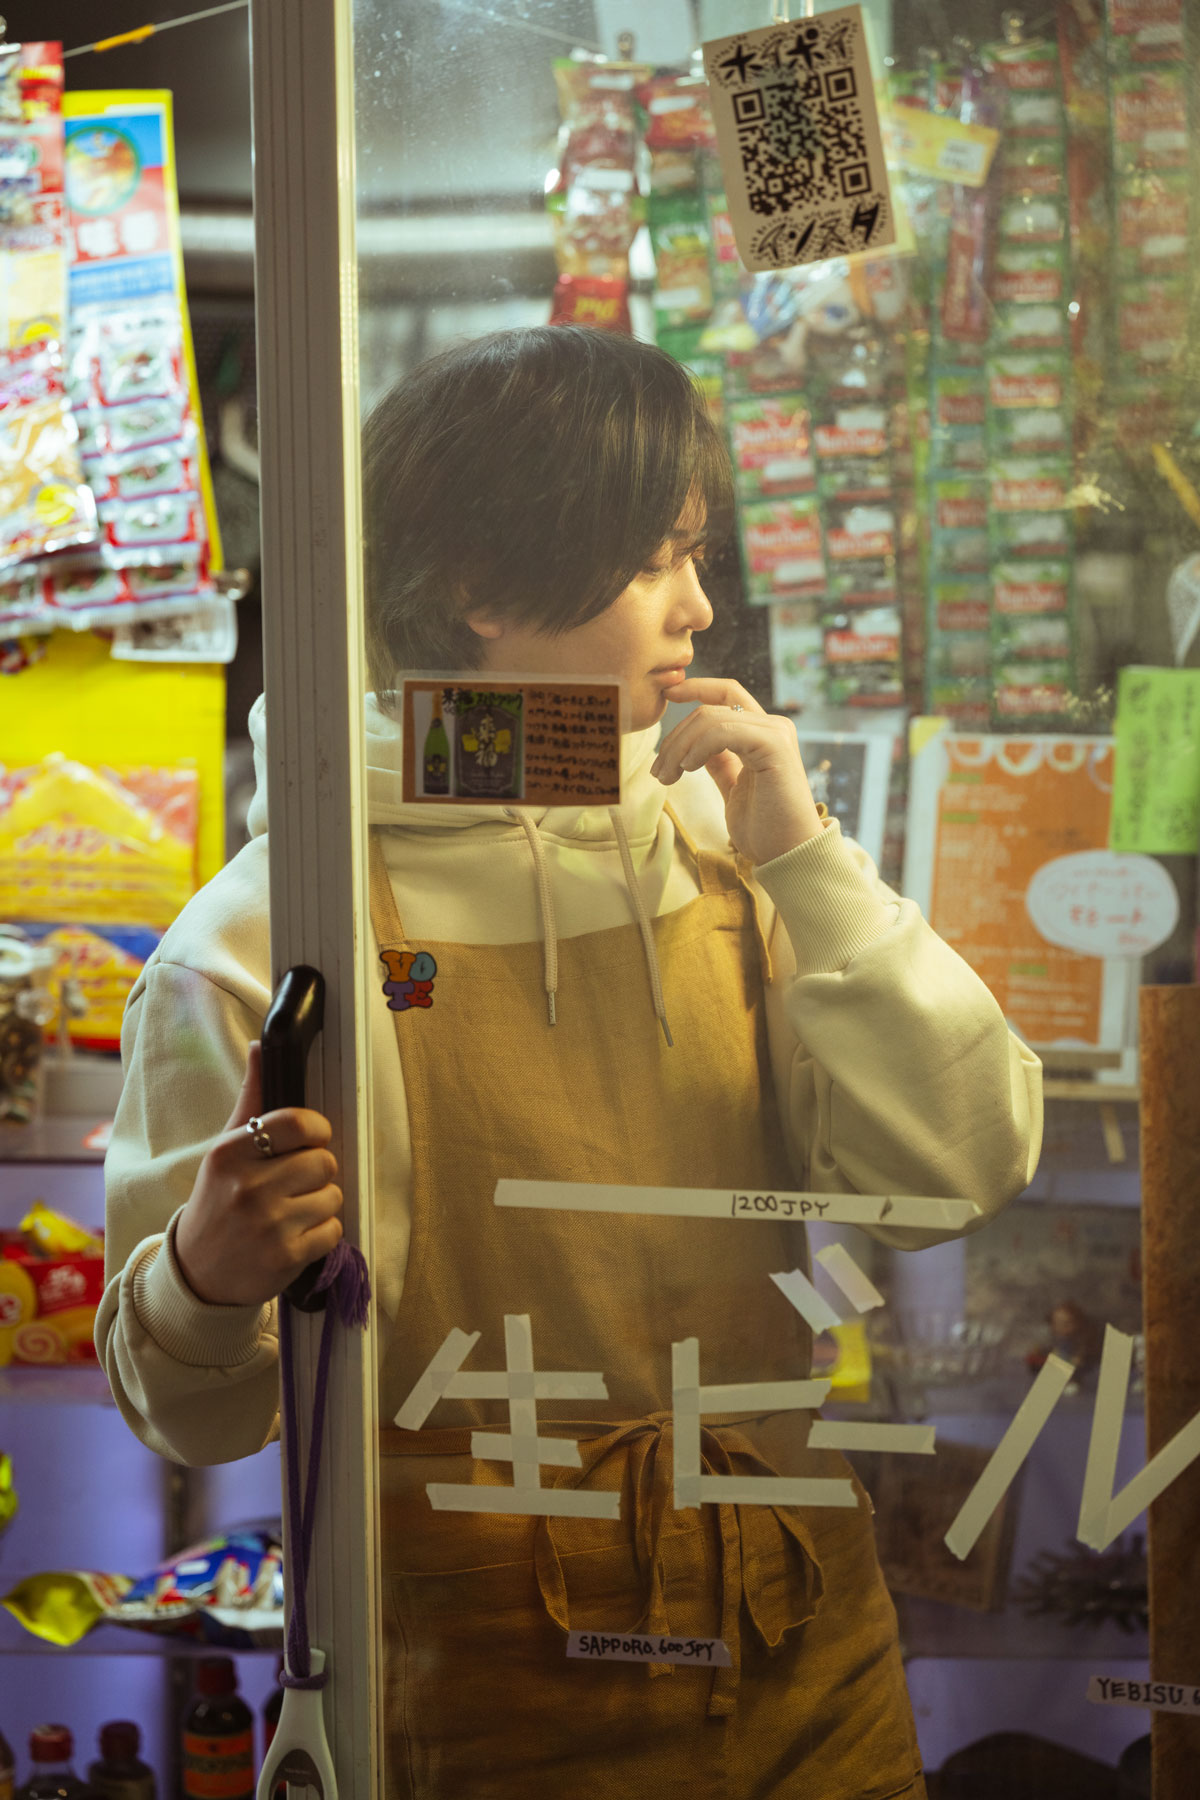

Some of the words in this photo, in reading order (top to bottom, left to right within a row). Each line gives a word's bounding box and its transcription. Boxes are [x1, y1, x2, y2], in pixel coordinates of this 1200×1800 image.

[731, 1194, 830, 1217] 1200JPY
[394, 1243, 1200, 1560] 生ビール
